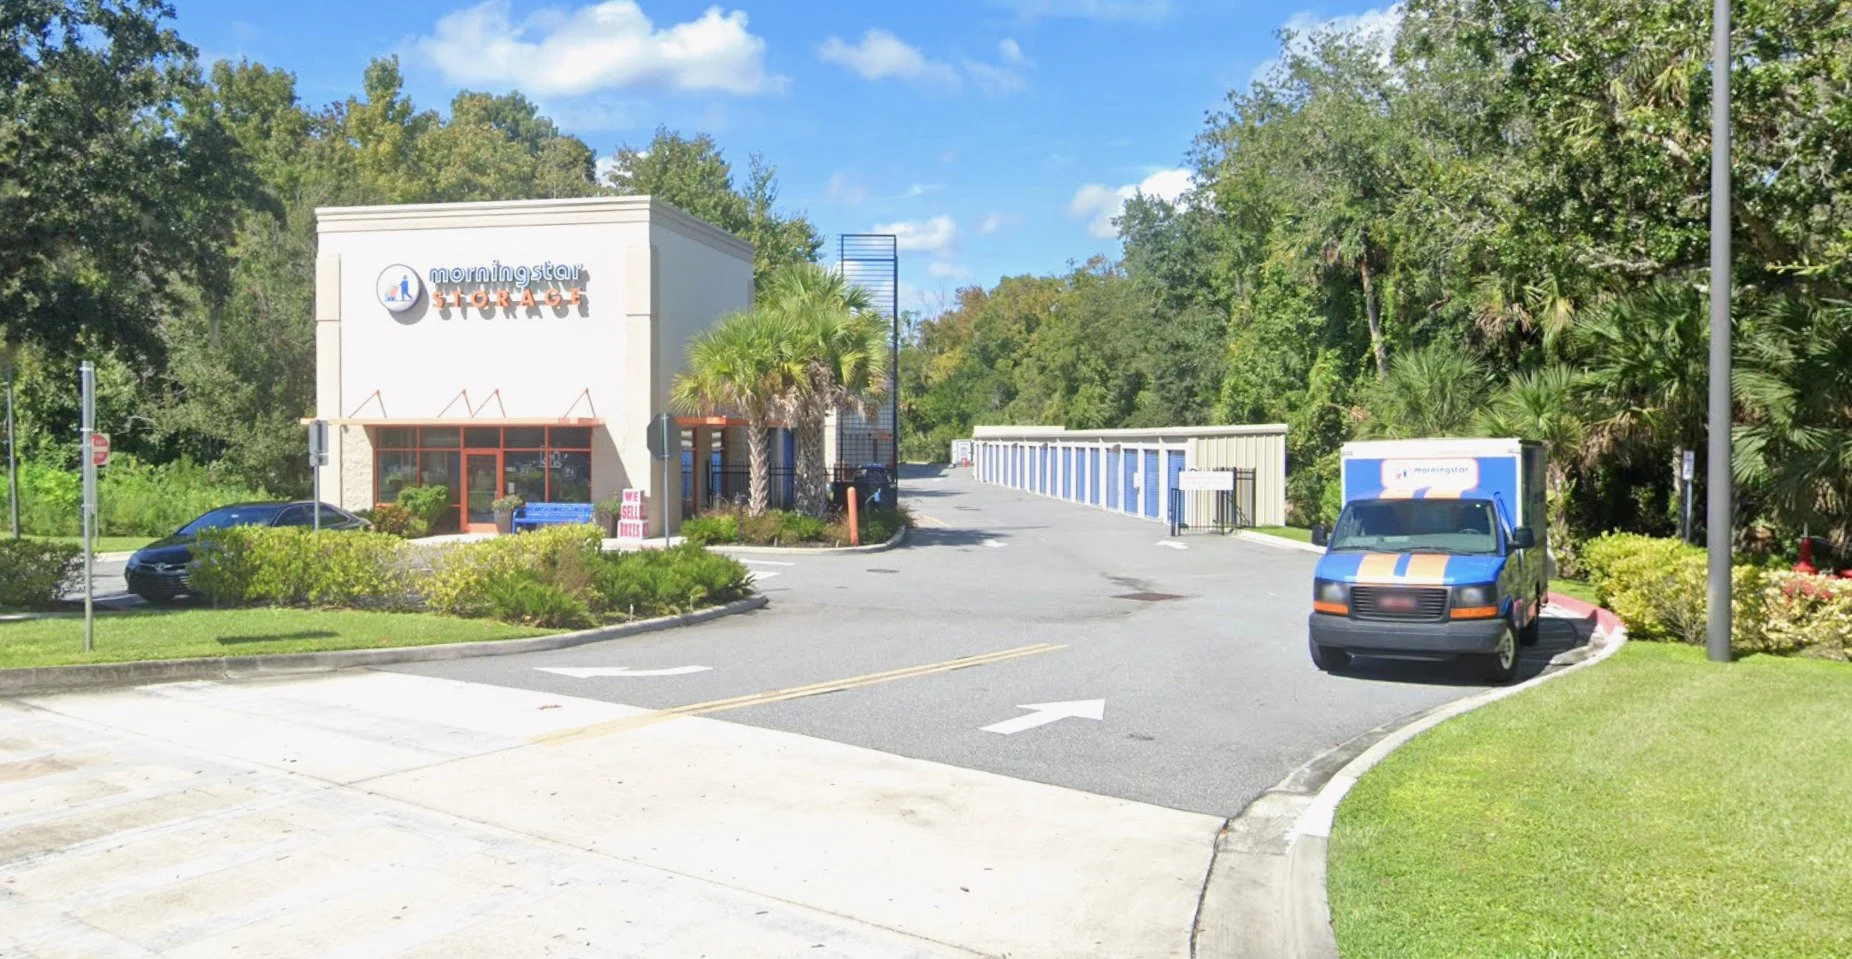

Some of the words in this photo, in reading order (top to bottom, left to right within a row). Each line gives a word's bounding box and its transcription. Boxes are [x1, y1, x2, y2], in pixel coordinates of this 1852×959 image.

[430, 260, 583, 288] morningstar
[432, 287, 581, 309] STORAGE
[1414, 466, 1468, 475] morningstar
[624, 491, 639, 502] WE
[622, 504, 639, 520] SELL
[620, 522, 640, 538] BOXES
